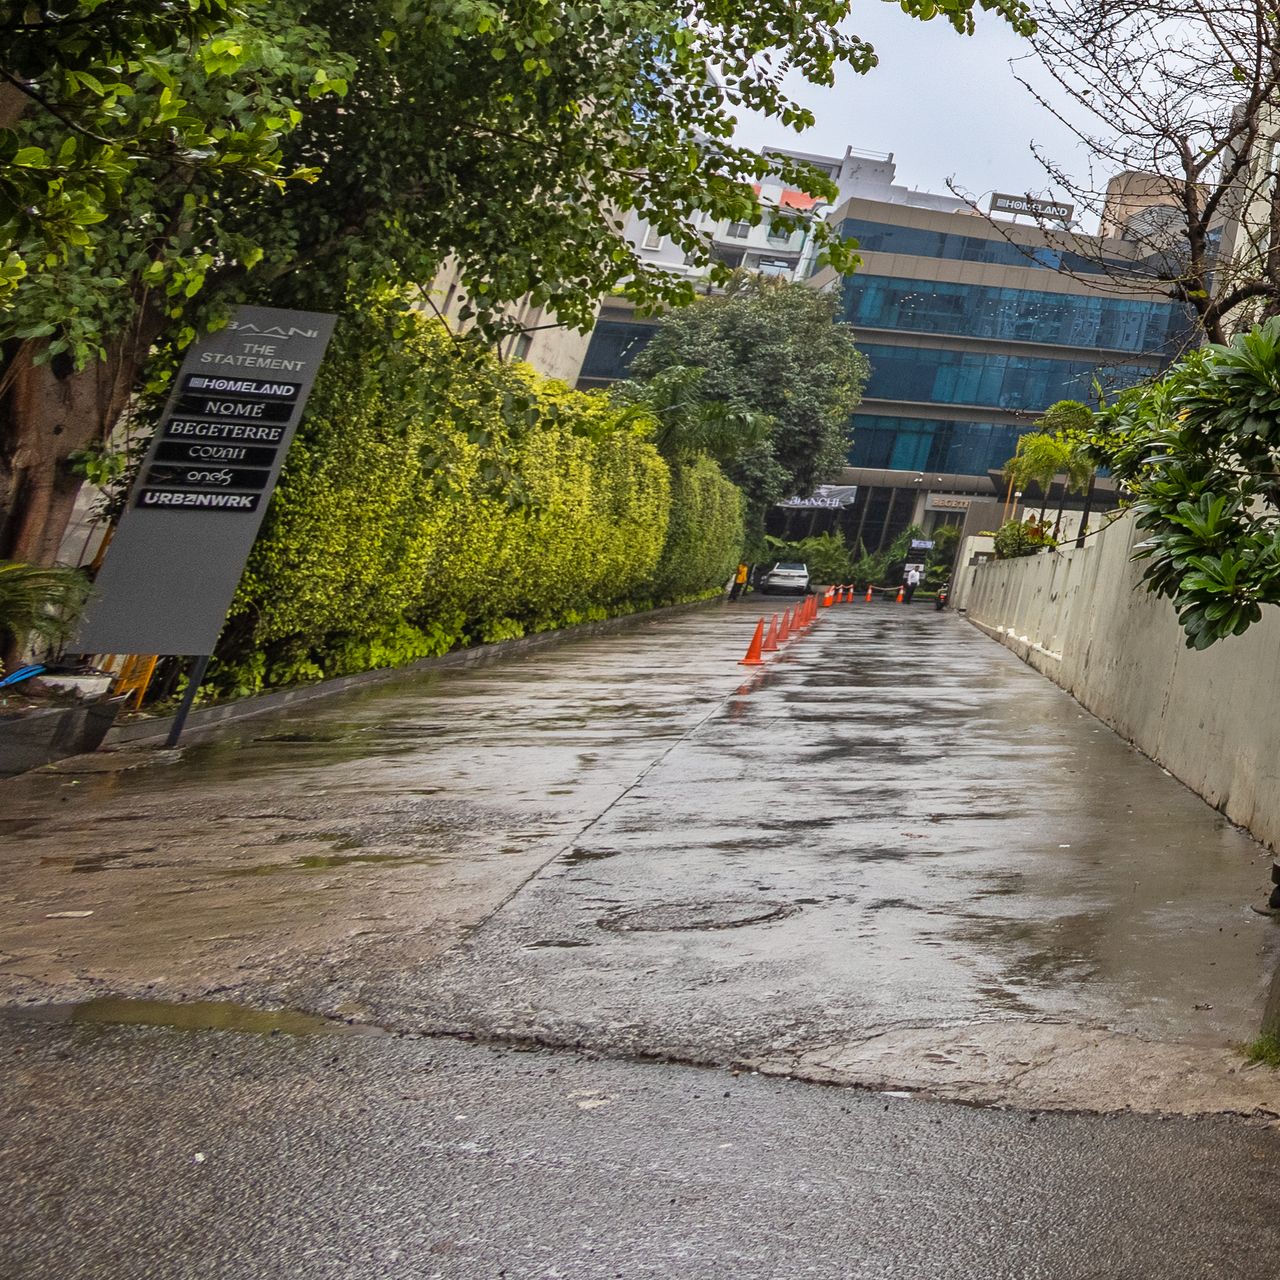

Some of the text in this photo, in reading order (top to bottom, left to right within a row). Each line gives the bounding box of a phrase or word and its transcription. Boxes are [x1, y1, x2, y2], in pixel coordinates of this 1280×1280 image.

[243, 343, 277, 356] THE
[200, 352, 306, 371] STATEMENT
[202, 378, 295, 396] HOMELAND
[170, 421, 282, 441] BEGETERRE
